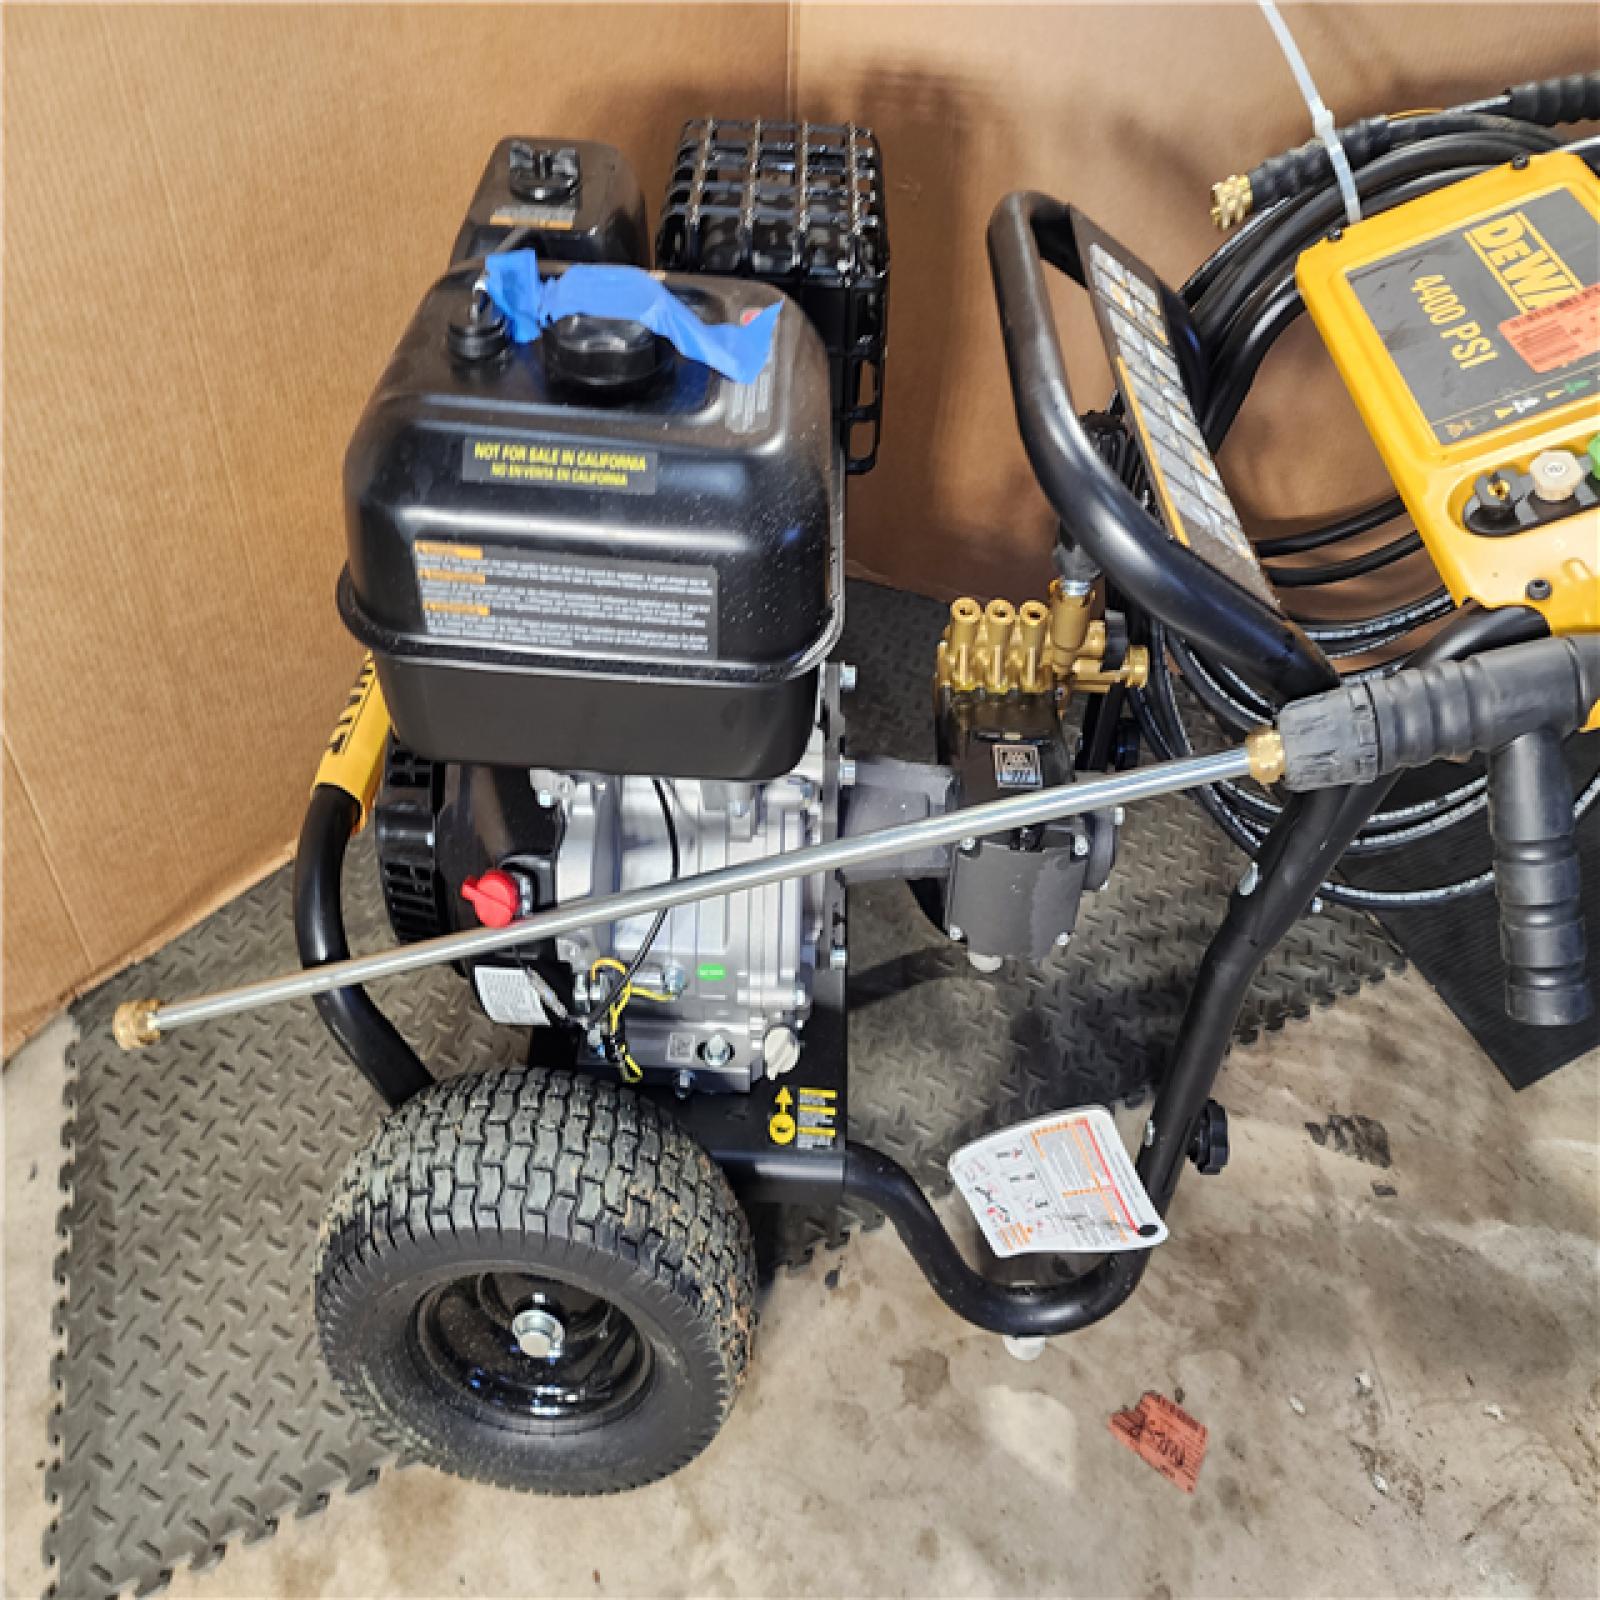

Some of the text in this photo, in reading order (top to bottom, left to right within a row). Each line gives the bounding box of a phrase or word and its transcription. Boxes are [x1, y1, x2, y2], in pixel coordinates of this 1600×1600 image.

[1410, 274, 1498, 369] 4400 PSI
[474, 441, 646, 472] NOT FOR SALE IN CALIFORNIA
[572, 468, 628, 487] CALIFORNIA
